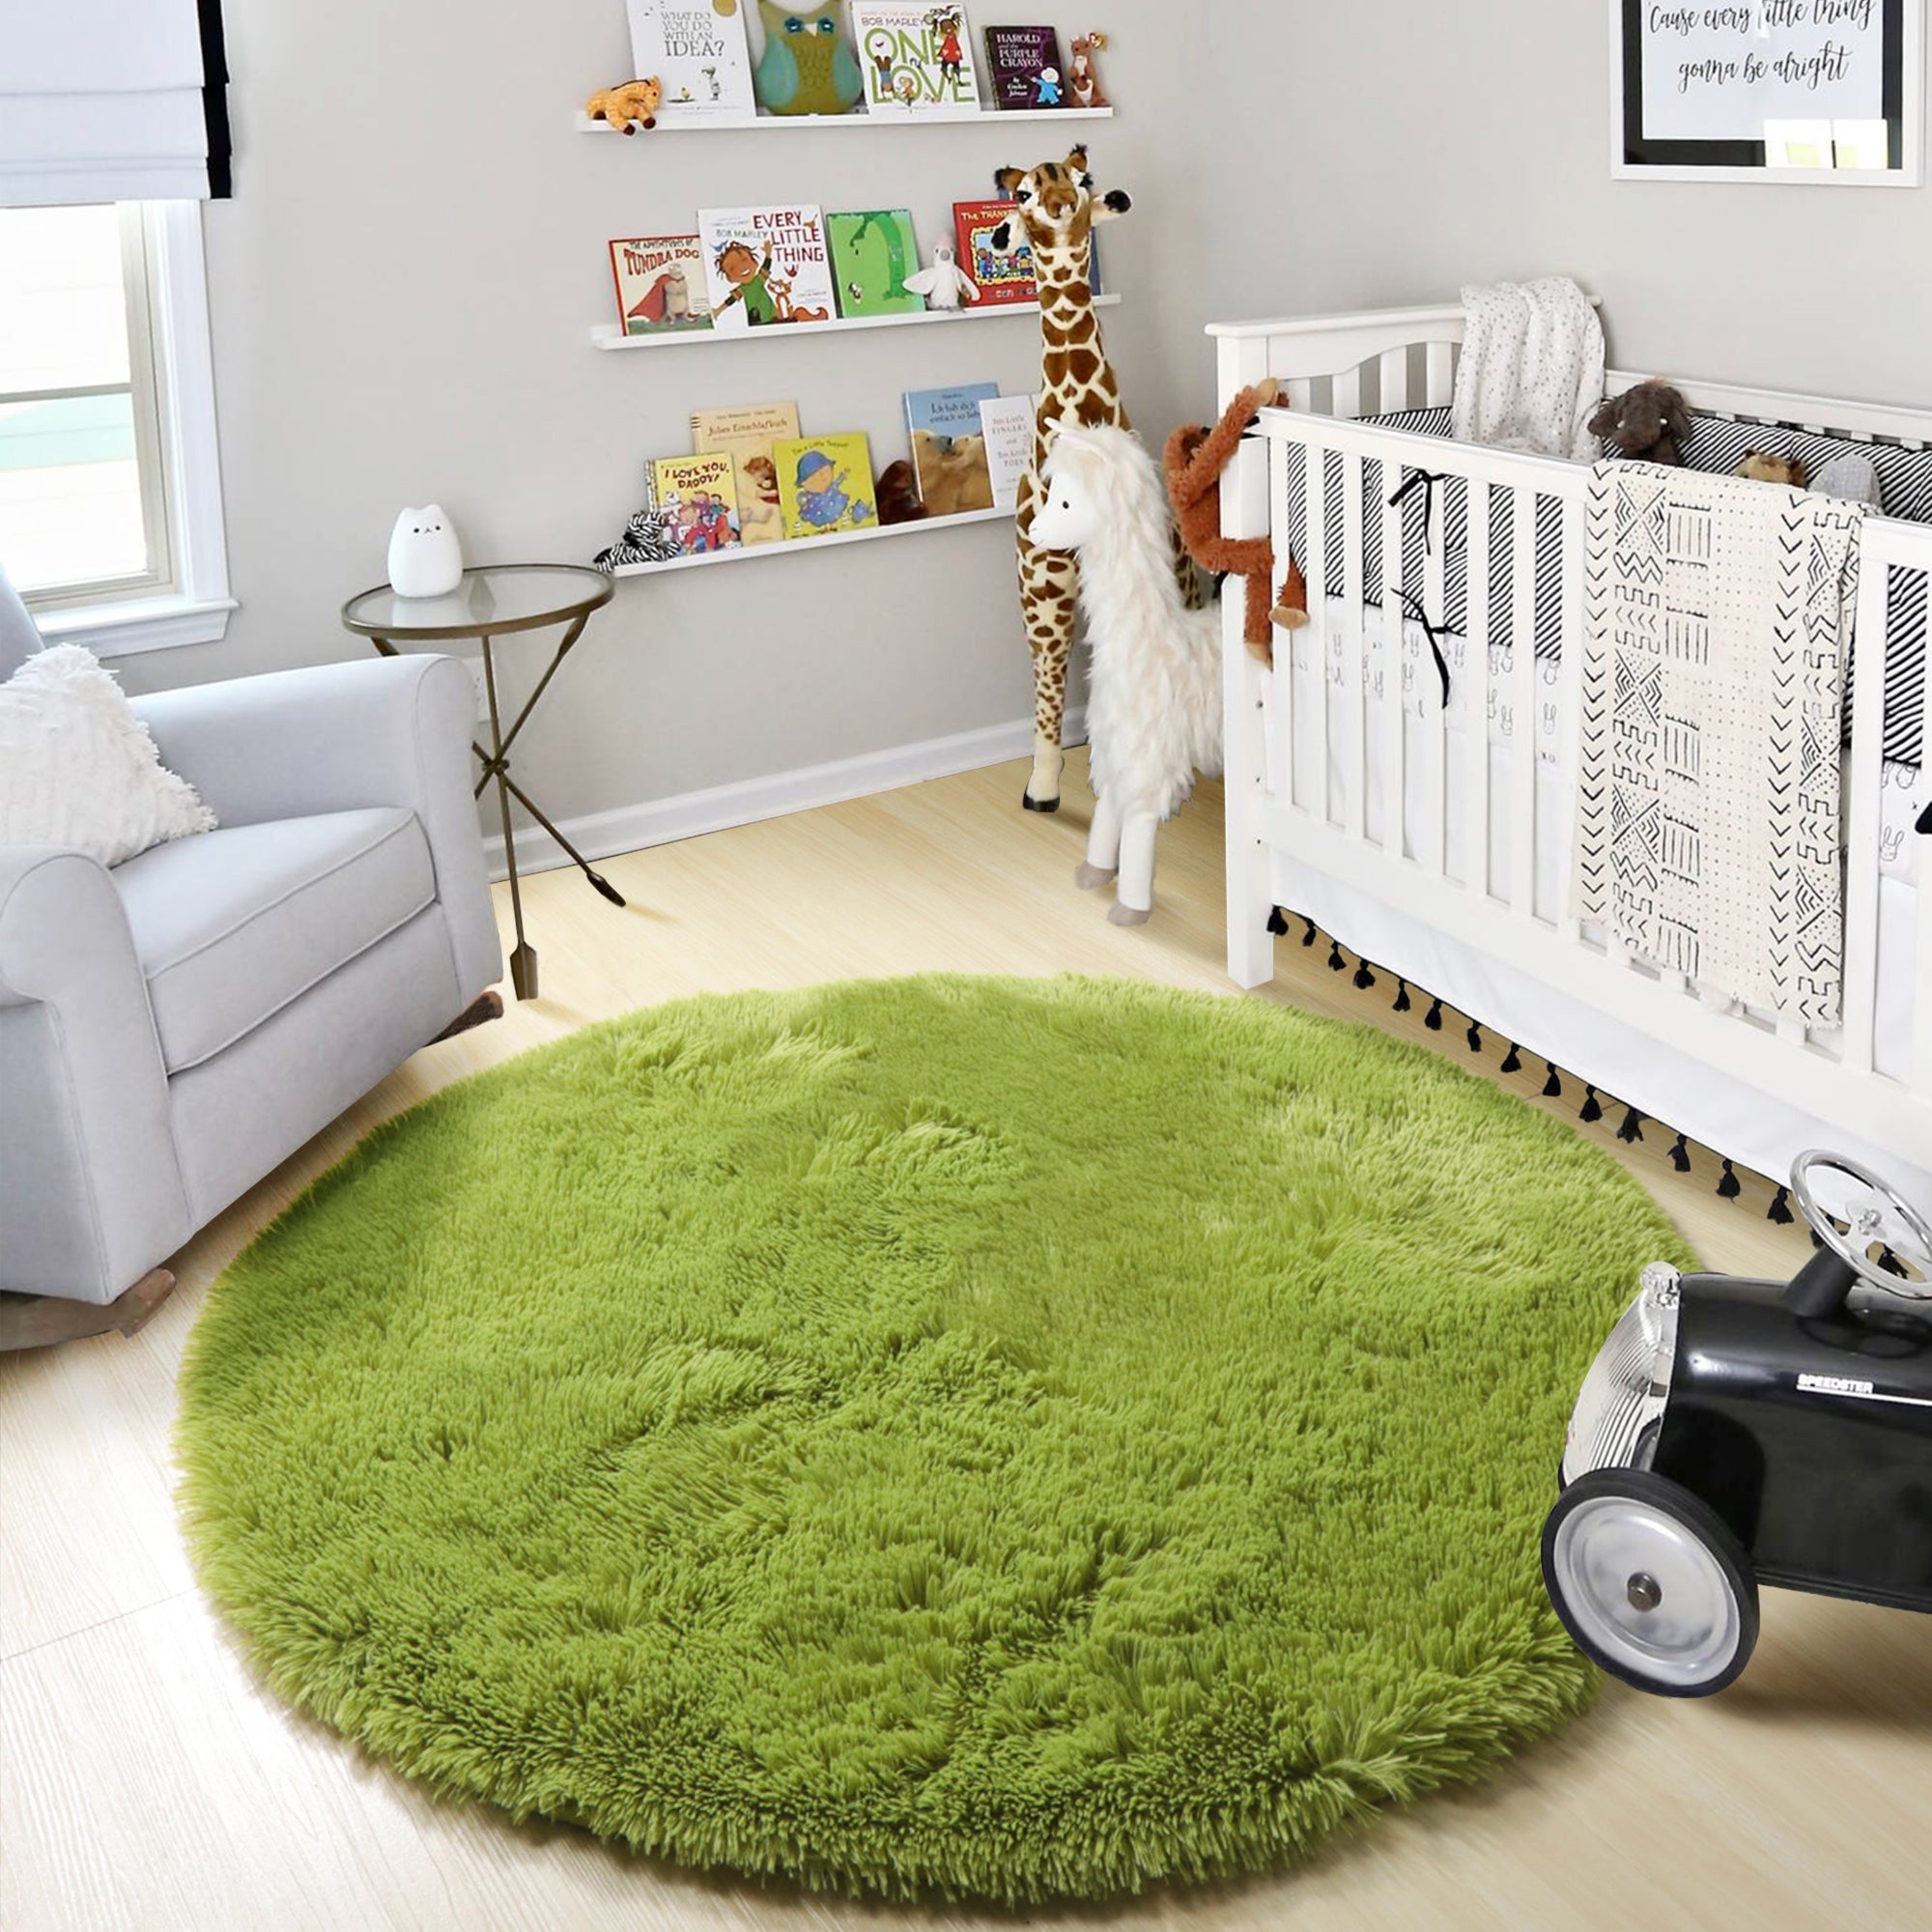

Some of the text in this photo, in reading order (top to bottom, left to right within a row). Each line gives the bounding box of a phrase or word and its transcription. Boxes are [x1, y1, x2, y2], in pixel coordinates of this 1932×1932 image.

[661, 12, 711, 20] WHAT DO
[861, 17, 924, 27] BOB MARLEY
[1704, 8, 1750, 34] every
[663, 20, 712, 31] YOU DO
[664, 32, 713, 41] WITH AN
[997, 34, 1040, 43] HAROLD
[665, 41, 724, 56] IDEA?
[999, 49, 1039, 58] PURPLE
[1000, 58, 1043, 67] CRAYON
[1678, 41, 1853, 94] gonna be alright
[870, 65, 976, 103] LOVE
[753, 211, 802, 230] EVERY
[772, 227, 821, 245] LITTLE
[623, 248, 699, 275] TUNDRA DOG
[775, 247, 824, 262] THING
[665, 469, 669, 478] I
[672, 467, 700, 479] LOVE
[677, 474, 720, 489] DADDY!
